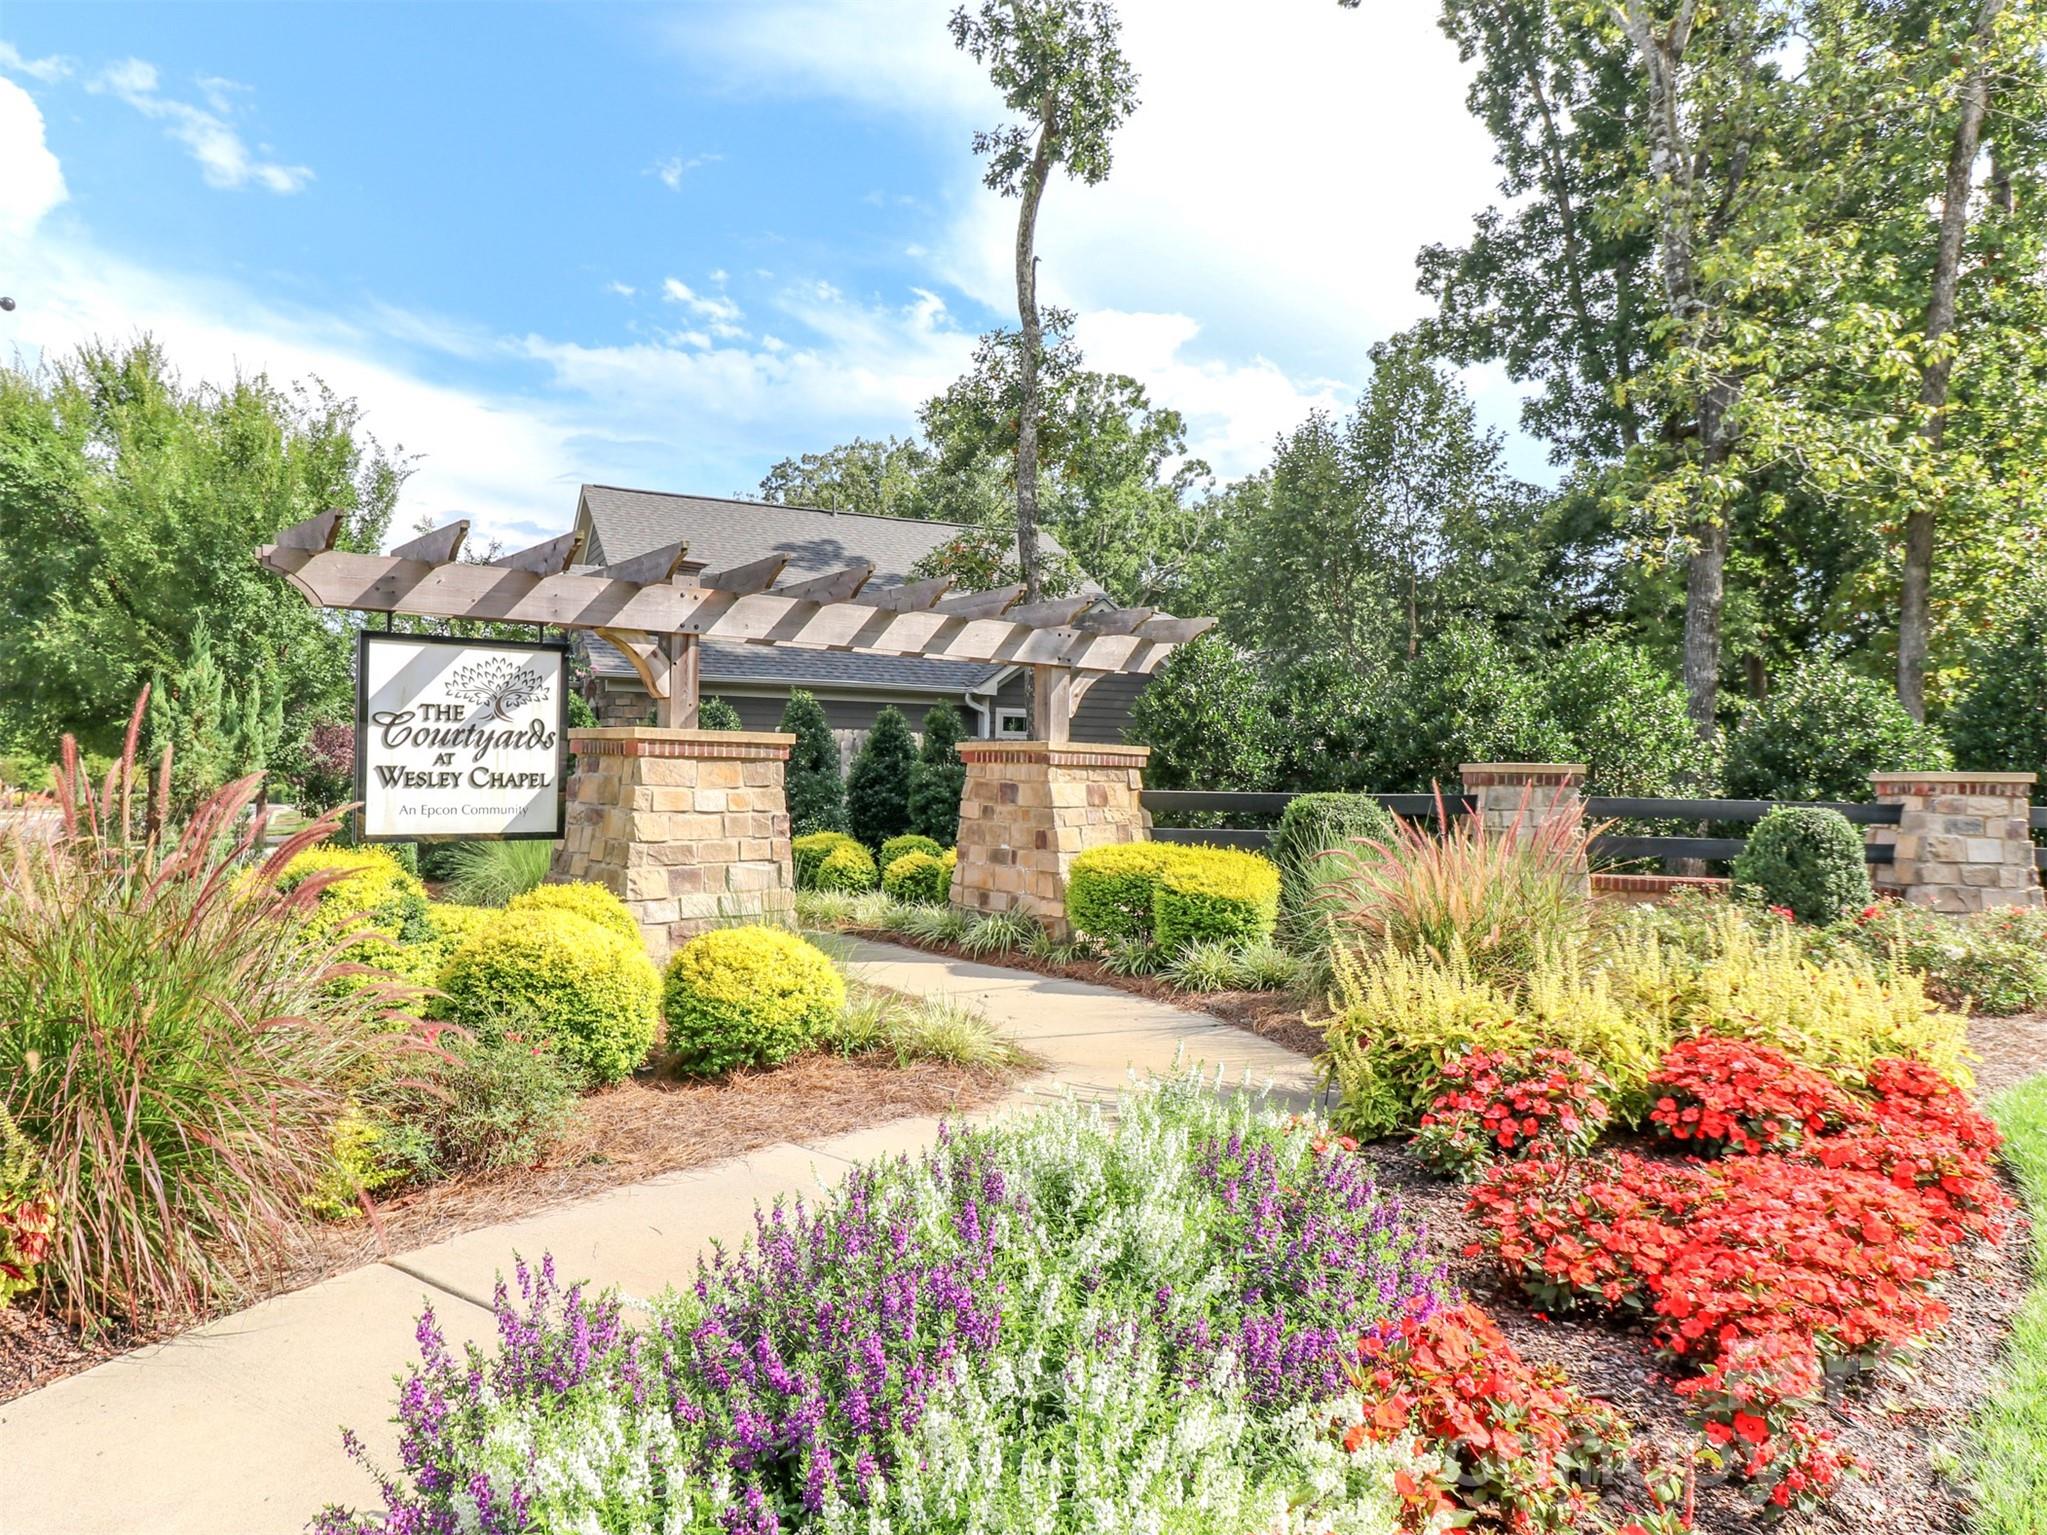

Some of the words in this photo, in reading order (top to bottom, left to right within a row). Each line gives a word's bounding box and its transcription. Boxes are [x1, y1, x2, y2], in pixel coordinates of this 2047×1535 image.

[417, 703, 465, 722] THE
[372, 711, 556, 762] Courtyards
[432, 753, 456, 766] AT
[373, 765, 463, 789] WESLEY
[468, 766, 550, 789] CHAPEL
[399, 804, 417, 816] An
[421, 804, 458, 818] Epcon
[461, 804, 529, 818] Community
